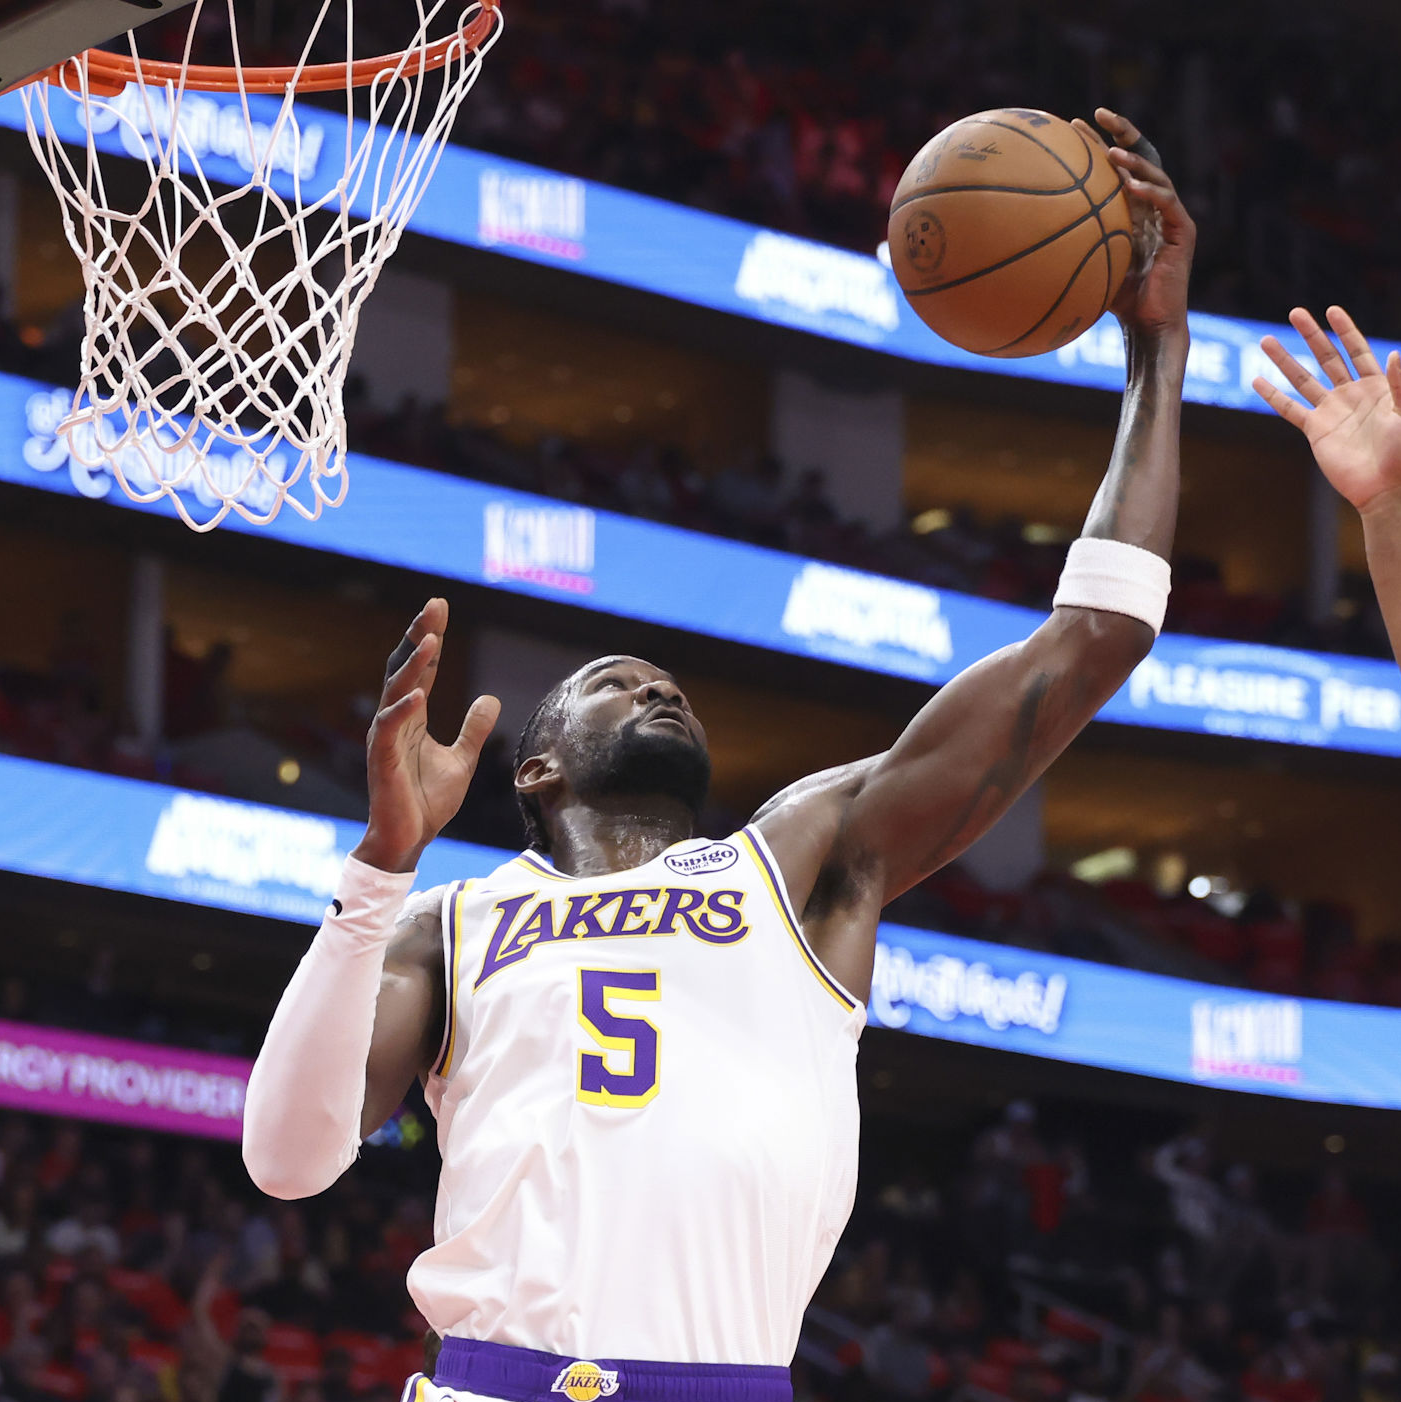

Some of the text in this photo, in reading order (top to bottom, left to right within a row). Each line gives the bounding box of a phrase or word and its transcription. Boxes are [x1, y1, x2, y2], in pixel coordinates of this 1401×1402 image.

[670, 850, 734, 867] bibigo
[473, 886, 753, 993] LAKERS
[575, 967, 662, 1109] 5
[556, 1370, 616, 1396] LAKERS
